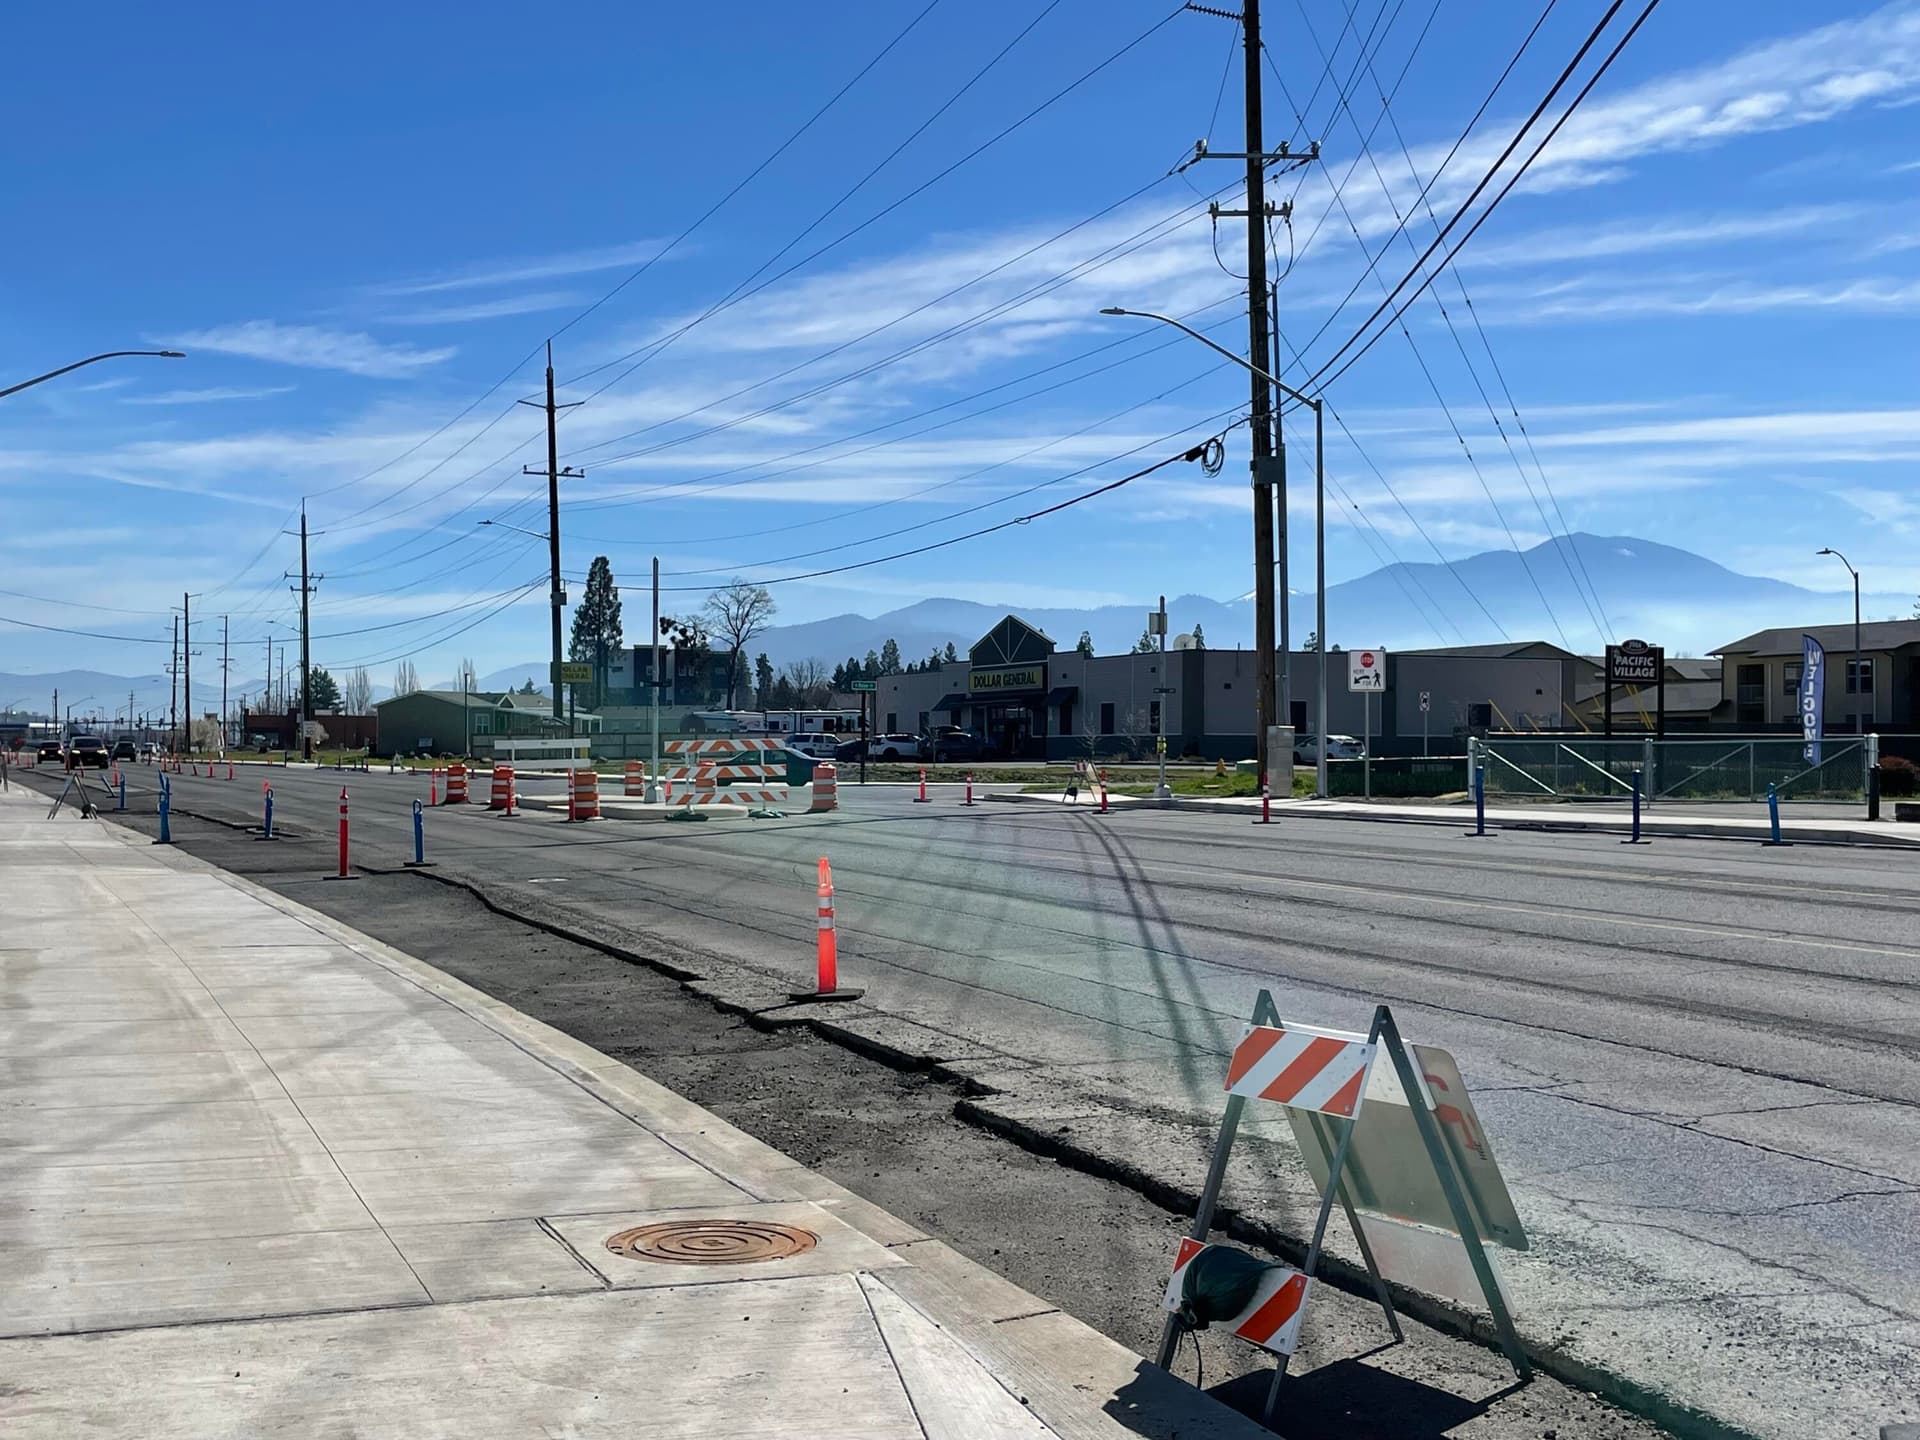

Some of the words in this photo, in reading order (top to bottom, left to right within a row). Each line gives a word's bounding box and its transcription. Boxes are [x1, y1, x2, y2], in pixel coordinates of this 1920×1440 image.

[1361, 656, 1374, 664] STOP
[1615, 656, 1655, 667] PACIFIC
[1613, 666, 1656, 678] VILLAGE
[973, 673, 1002, 689] DOLLAR
[1003, 671, 1036, 687] GENERAL
